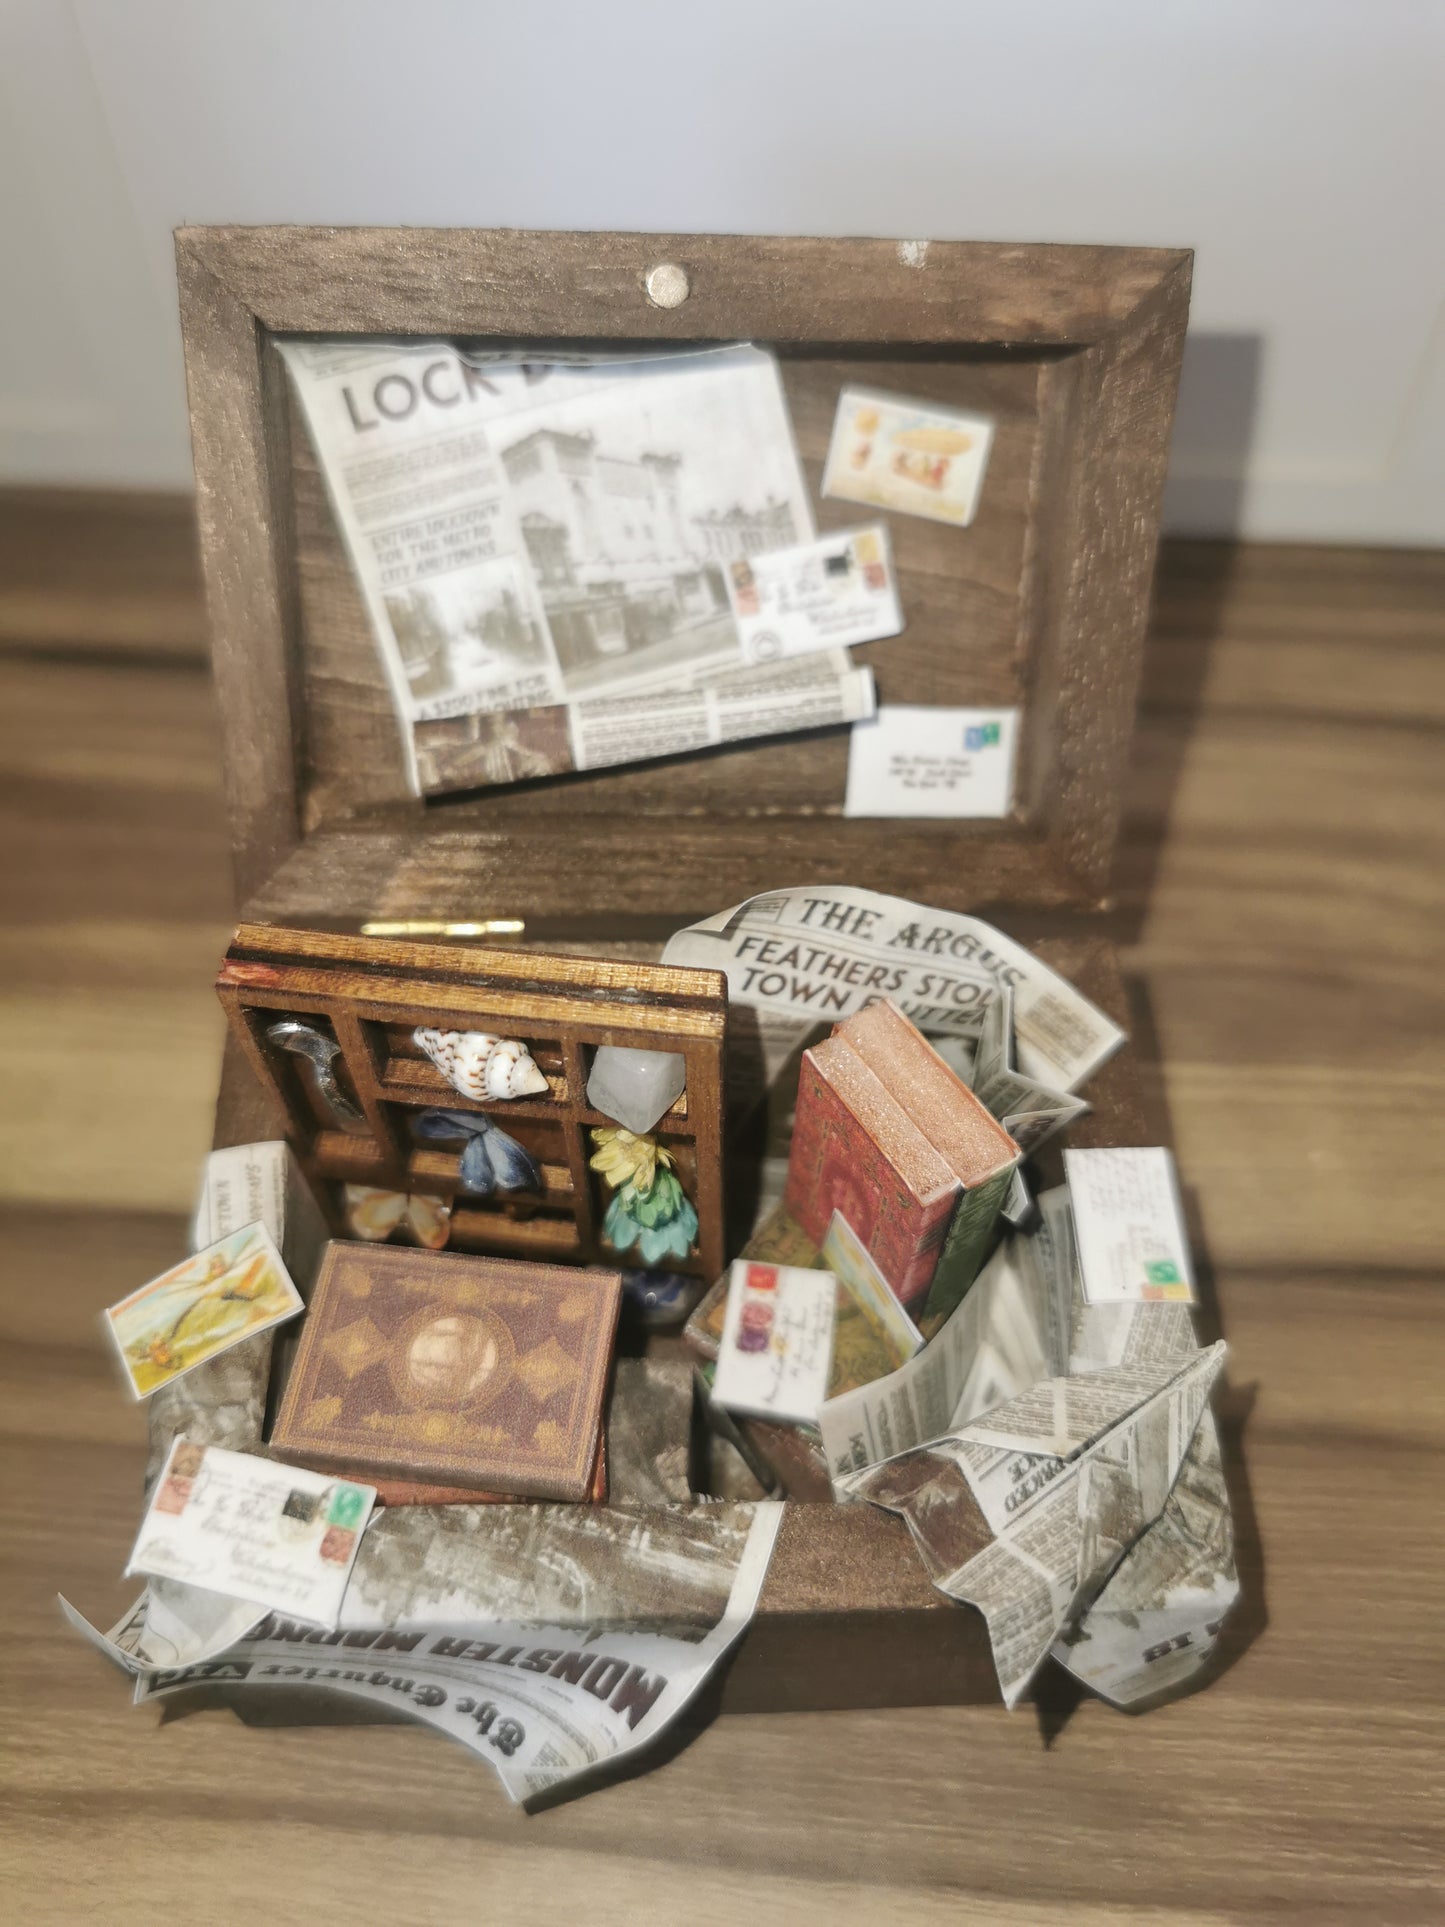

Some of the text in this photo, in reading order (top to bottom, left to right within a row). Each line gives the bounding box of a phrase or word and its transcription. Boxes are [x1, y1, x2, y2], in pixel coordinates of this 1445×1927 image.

[735, 936, 907, 991] FEATHERS
[800, 899, 1027, 986] THE ARGUS
[742, 967, 851, 1012] TOWN
[428, 1636, 669, 1732] MONSTER
[455, 1695, 526, 1756] The
